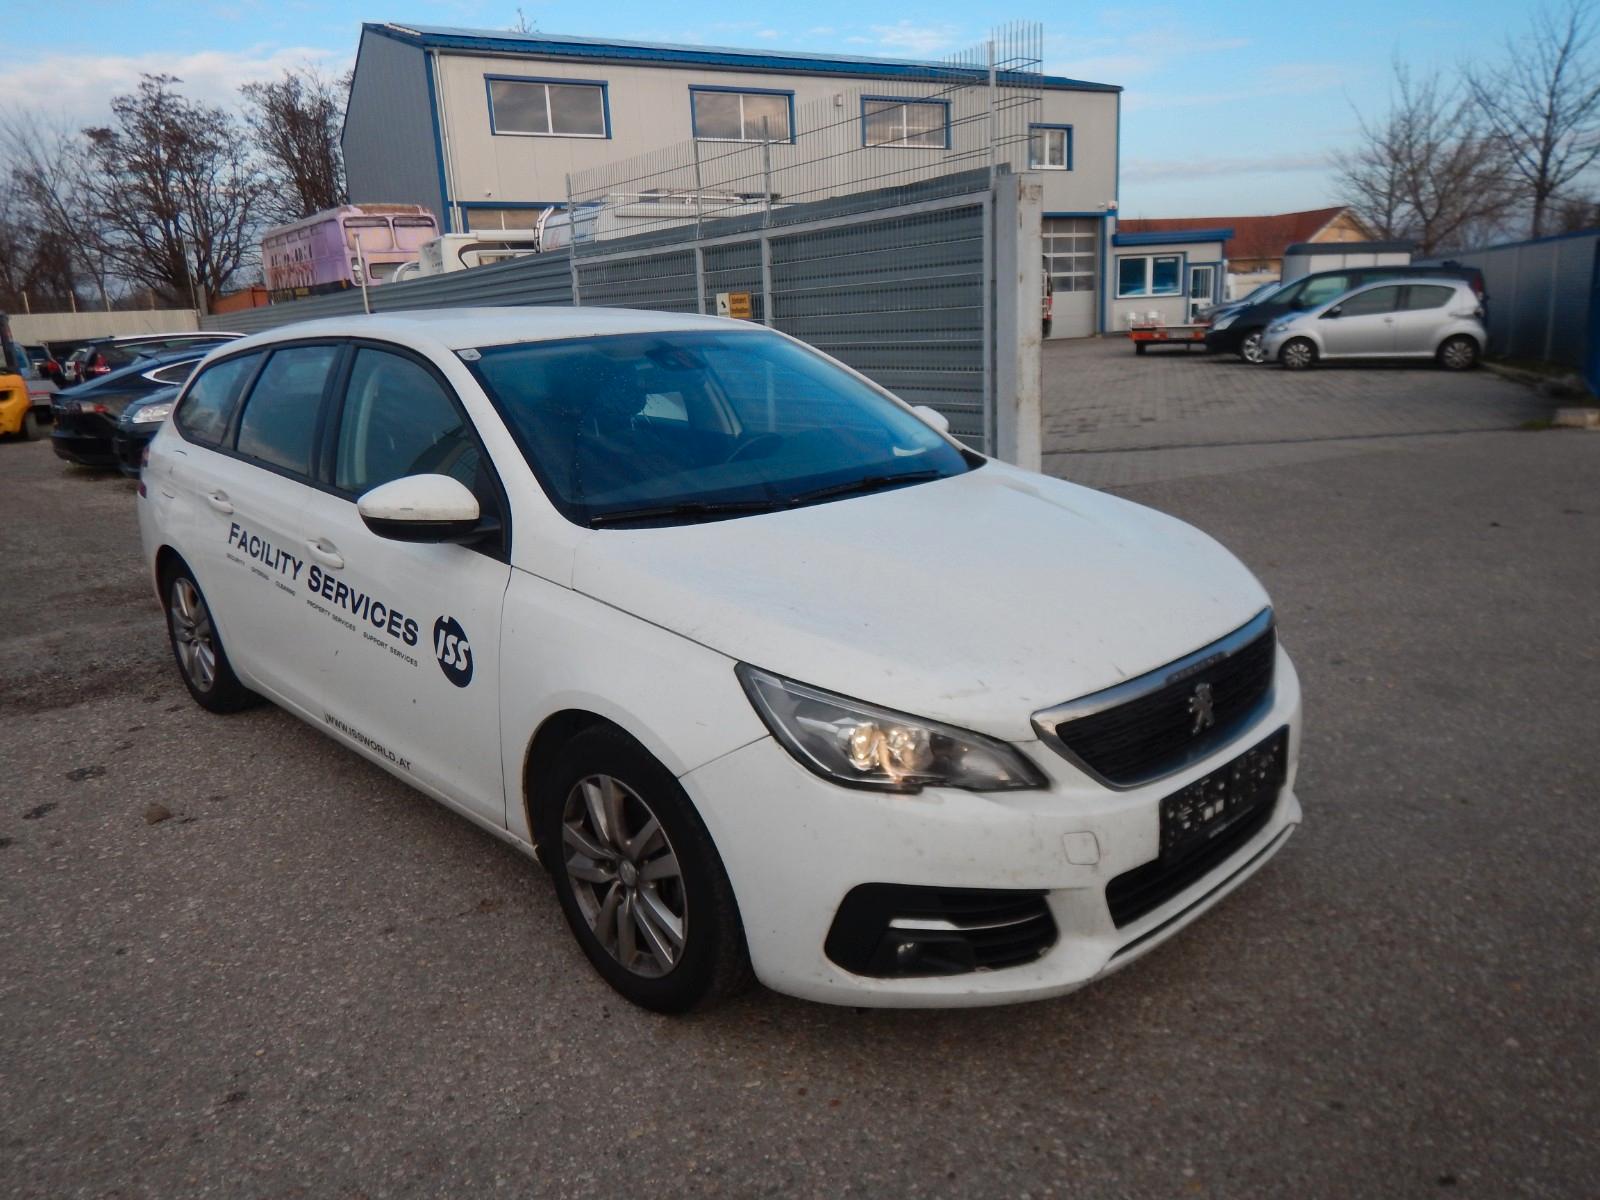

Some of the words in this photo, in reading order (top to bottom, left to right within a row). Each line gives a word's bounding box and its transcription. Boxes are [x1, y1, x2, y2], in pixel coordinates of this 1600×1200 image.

[228, 522, 304, 581] FACILITY
[307, 564, 419, 647] SERVICES
[306, 599, 331, 617] PROPERTY
[332, 613, 356, 632] SERVICES
[363, 631, 388, 650] SUPPORT
[390, 645, 419, 668] SERVICES
[436, 615, 470, 672] ISS
